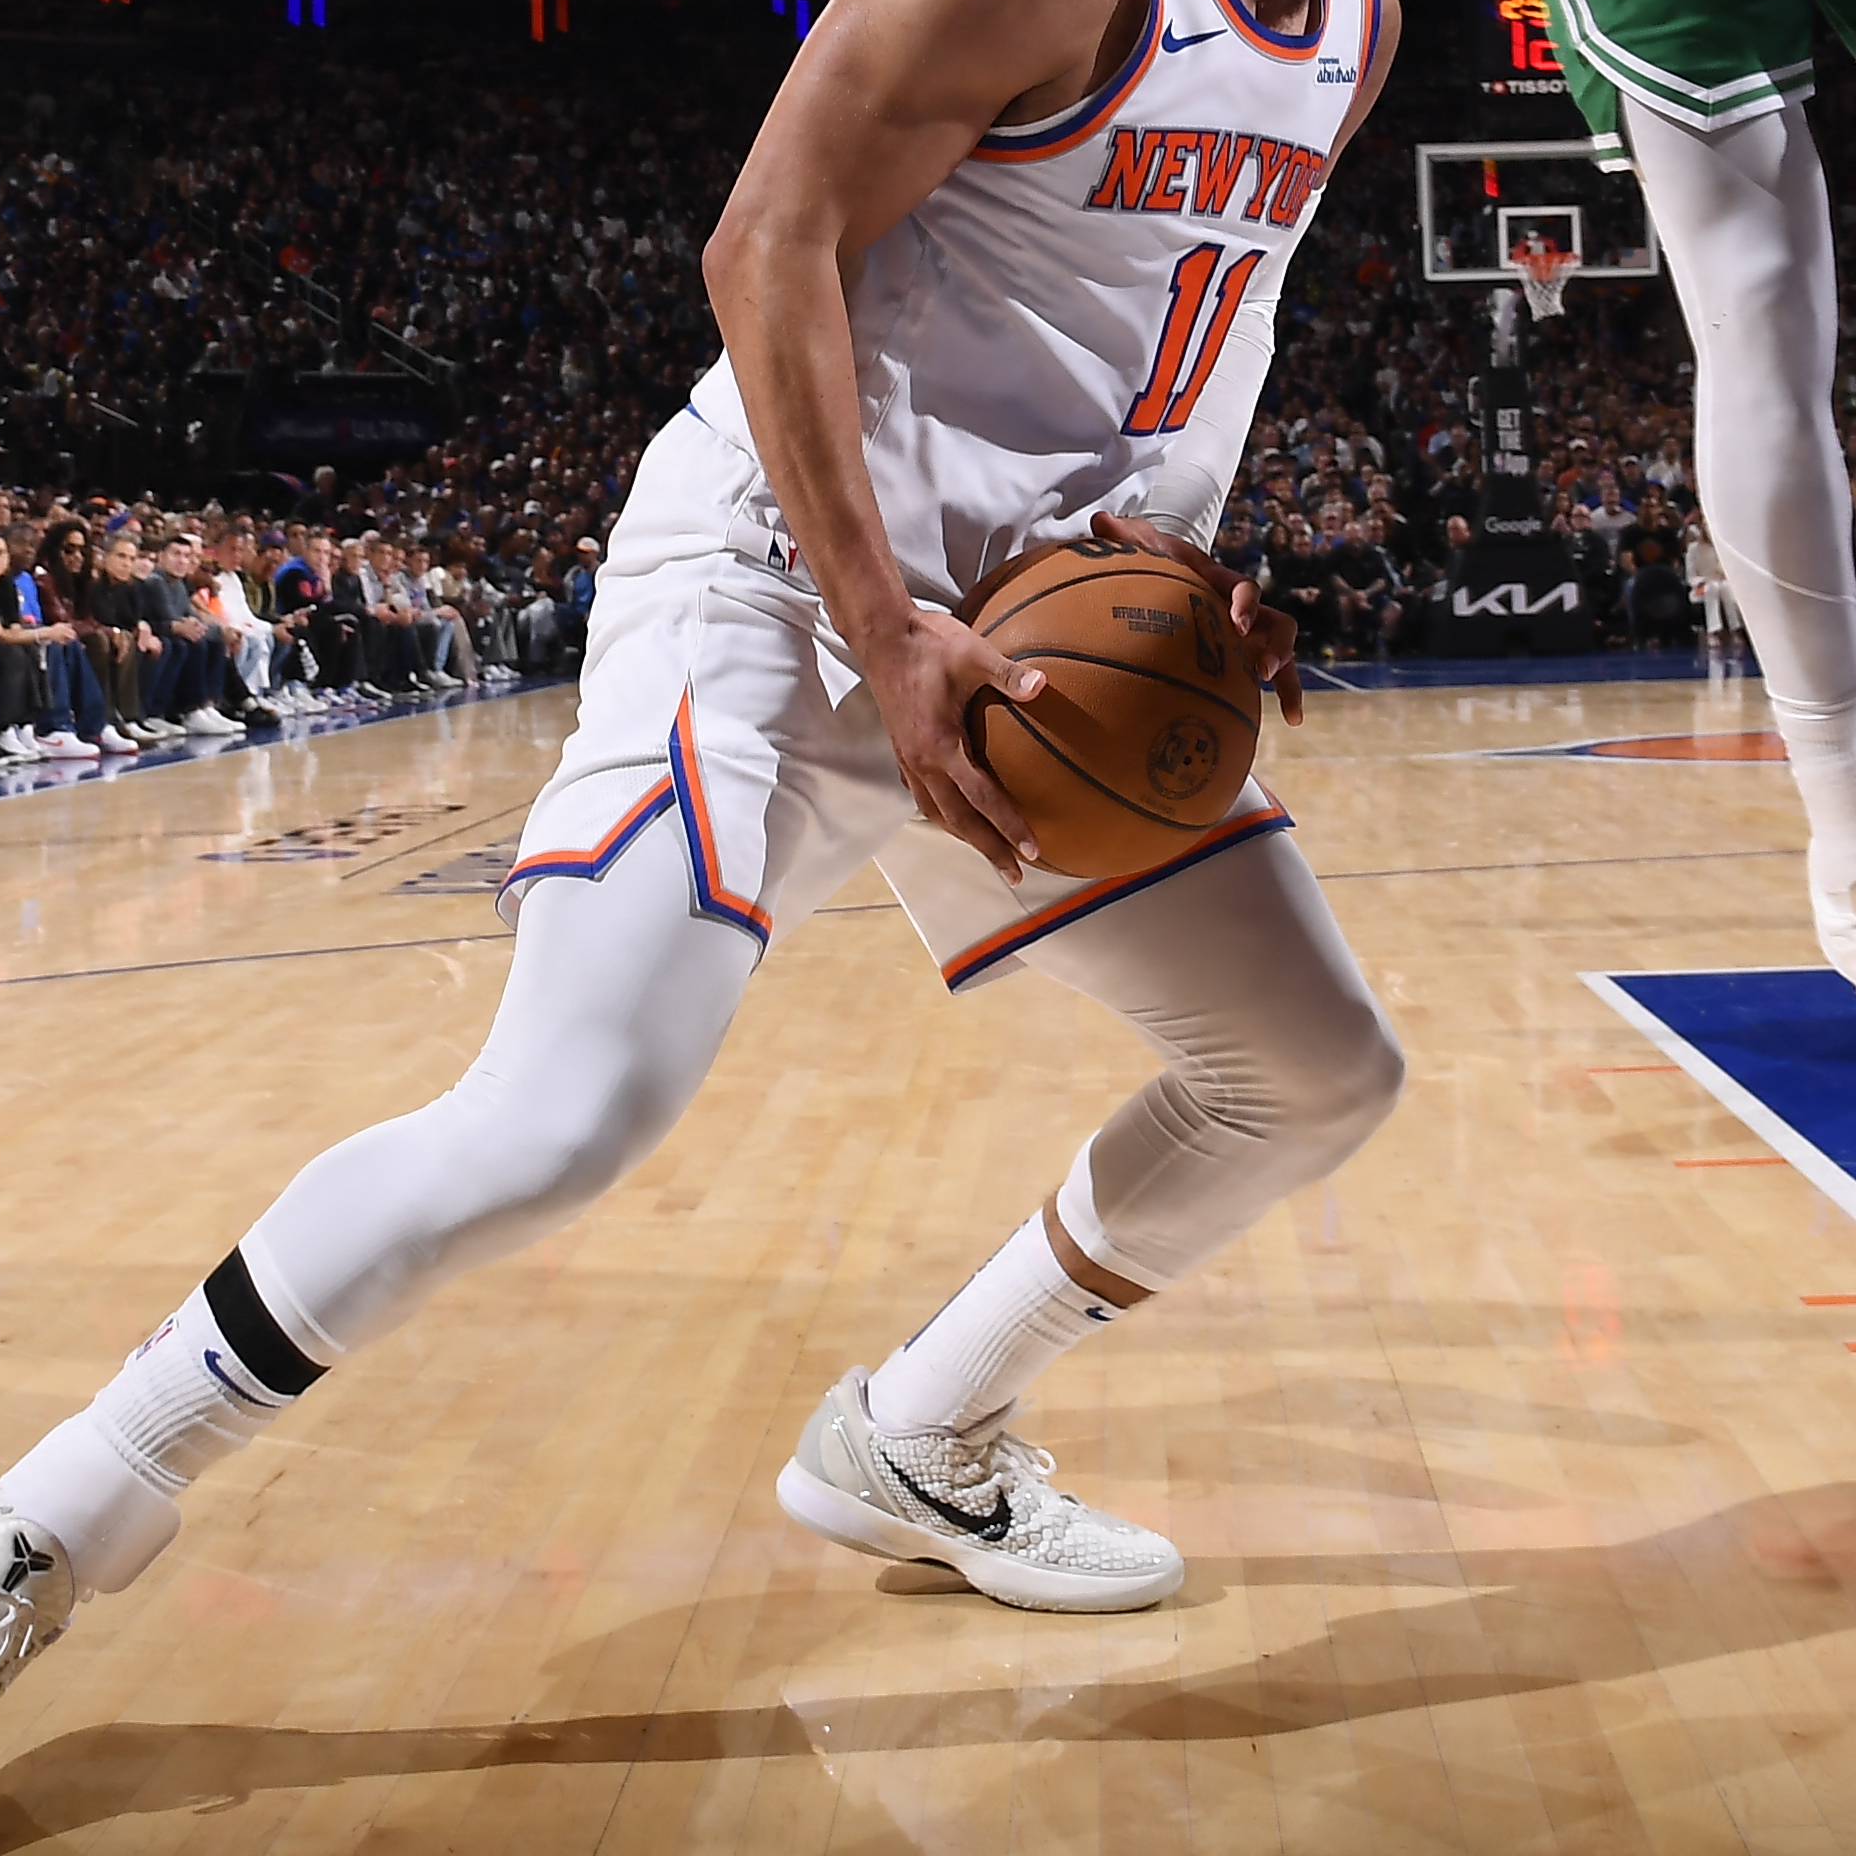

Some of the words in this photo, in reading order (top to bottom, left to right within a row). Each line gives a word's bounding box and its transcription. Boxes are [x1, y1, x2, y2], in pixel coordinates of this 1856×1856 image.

[1084, 125, 1256, 218] NEW
[1119, 241, 1268, 436] 11
[1484, 515, 1543, 537] Google
